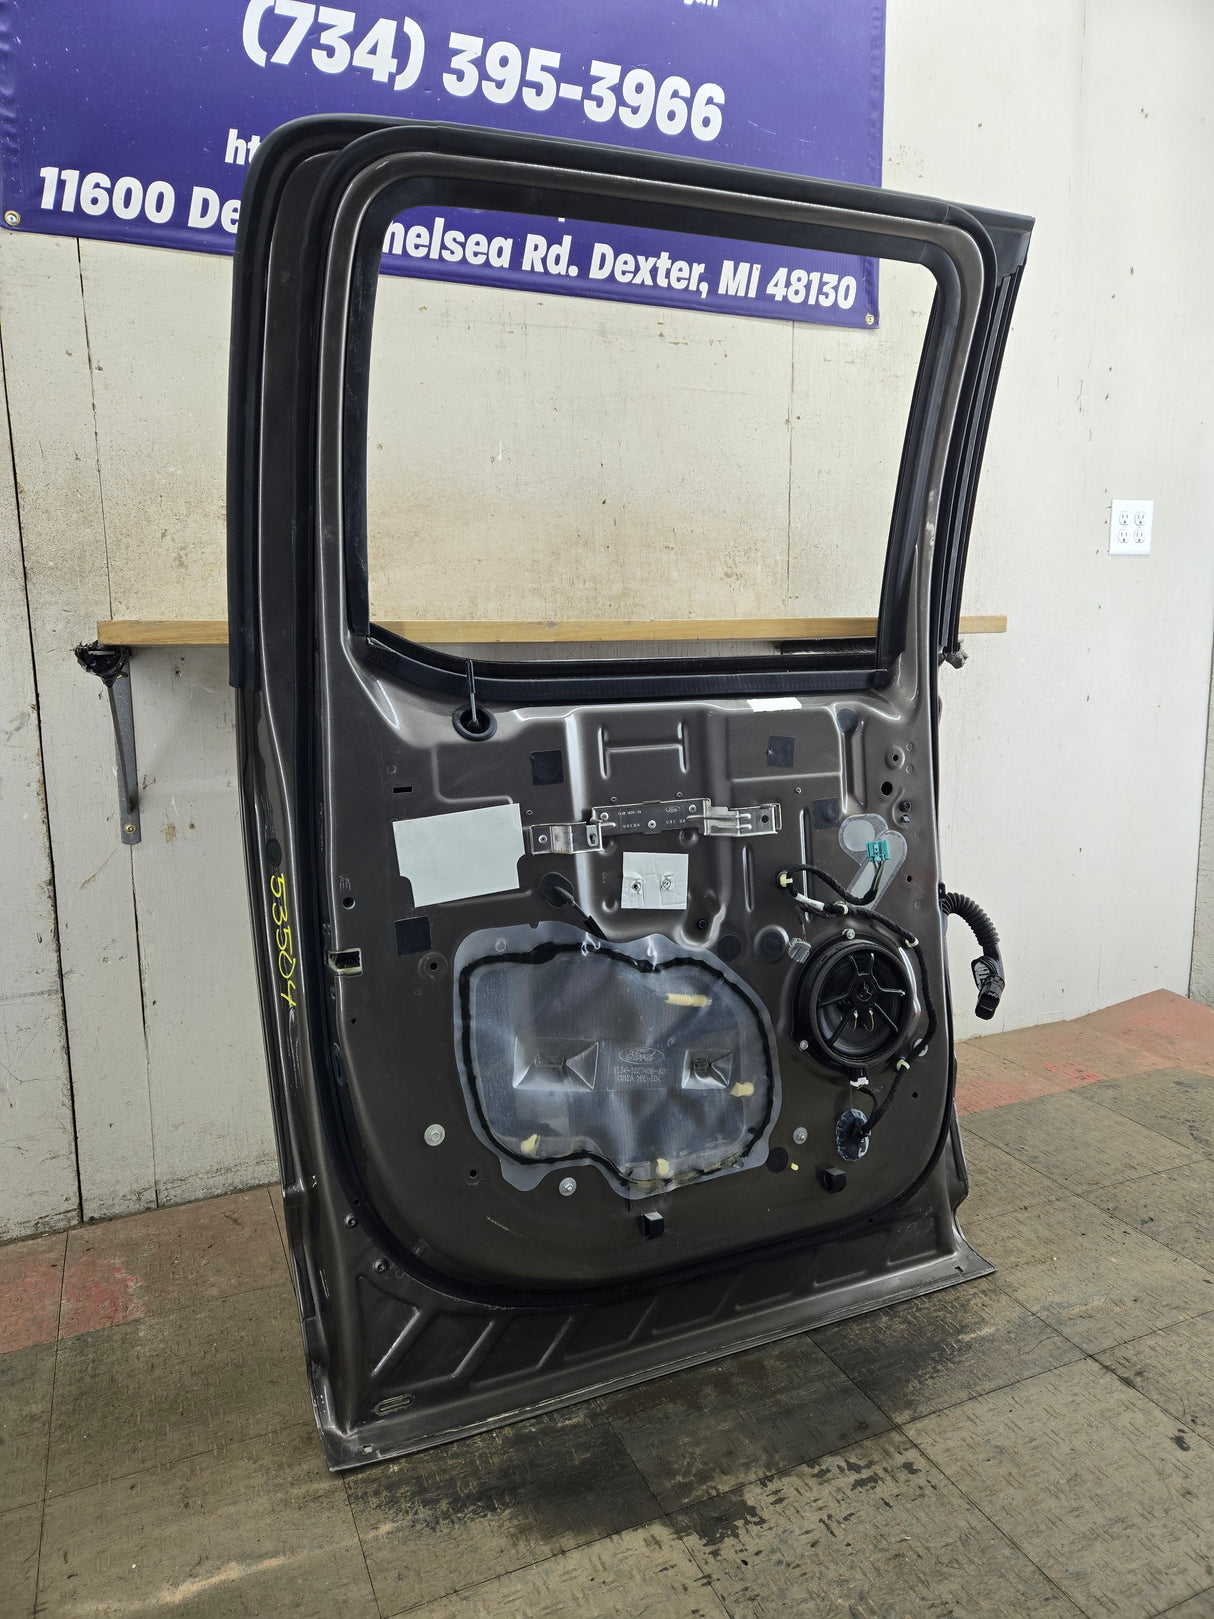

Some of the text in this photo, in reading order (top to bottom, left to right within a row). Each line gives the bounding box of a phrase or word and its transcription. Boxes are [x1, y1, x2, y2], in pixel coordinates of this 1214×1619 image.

[242, 0, 726, 142] (734) 395-3966
[40, 166, 176, 224] 11600
[188, 186, 242, 233] De
[522, 234, 579, 278] Rd.
[588, 242, 709, 299] Dexter,
[717, 259, 761, 298] MI
[766, 267, 857, 309] 48130
[270, 873, 297, 1008] 53504
